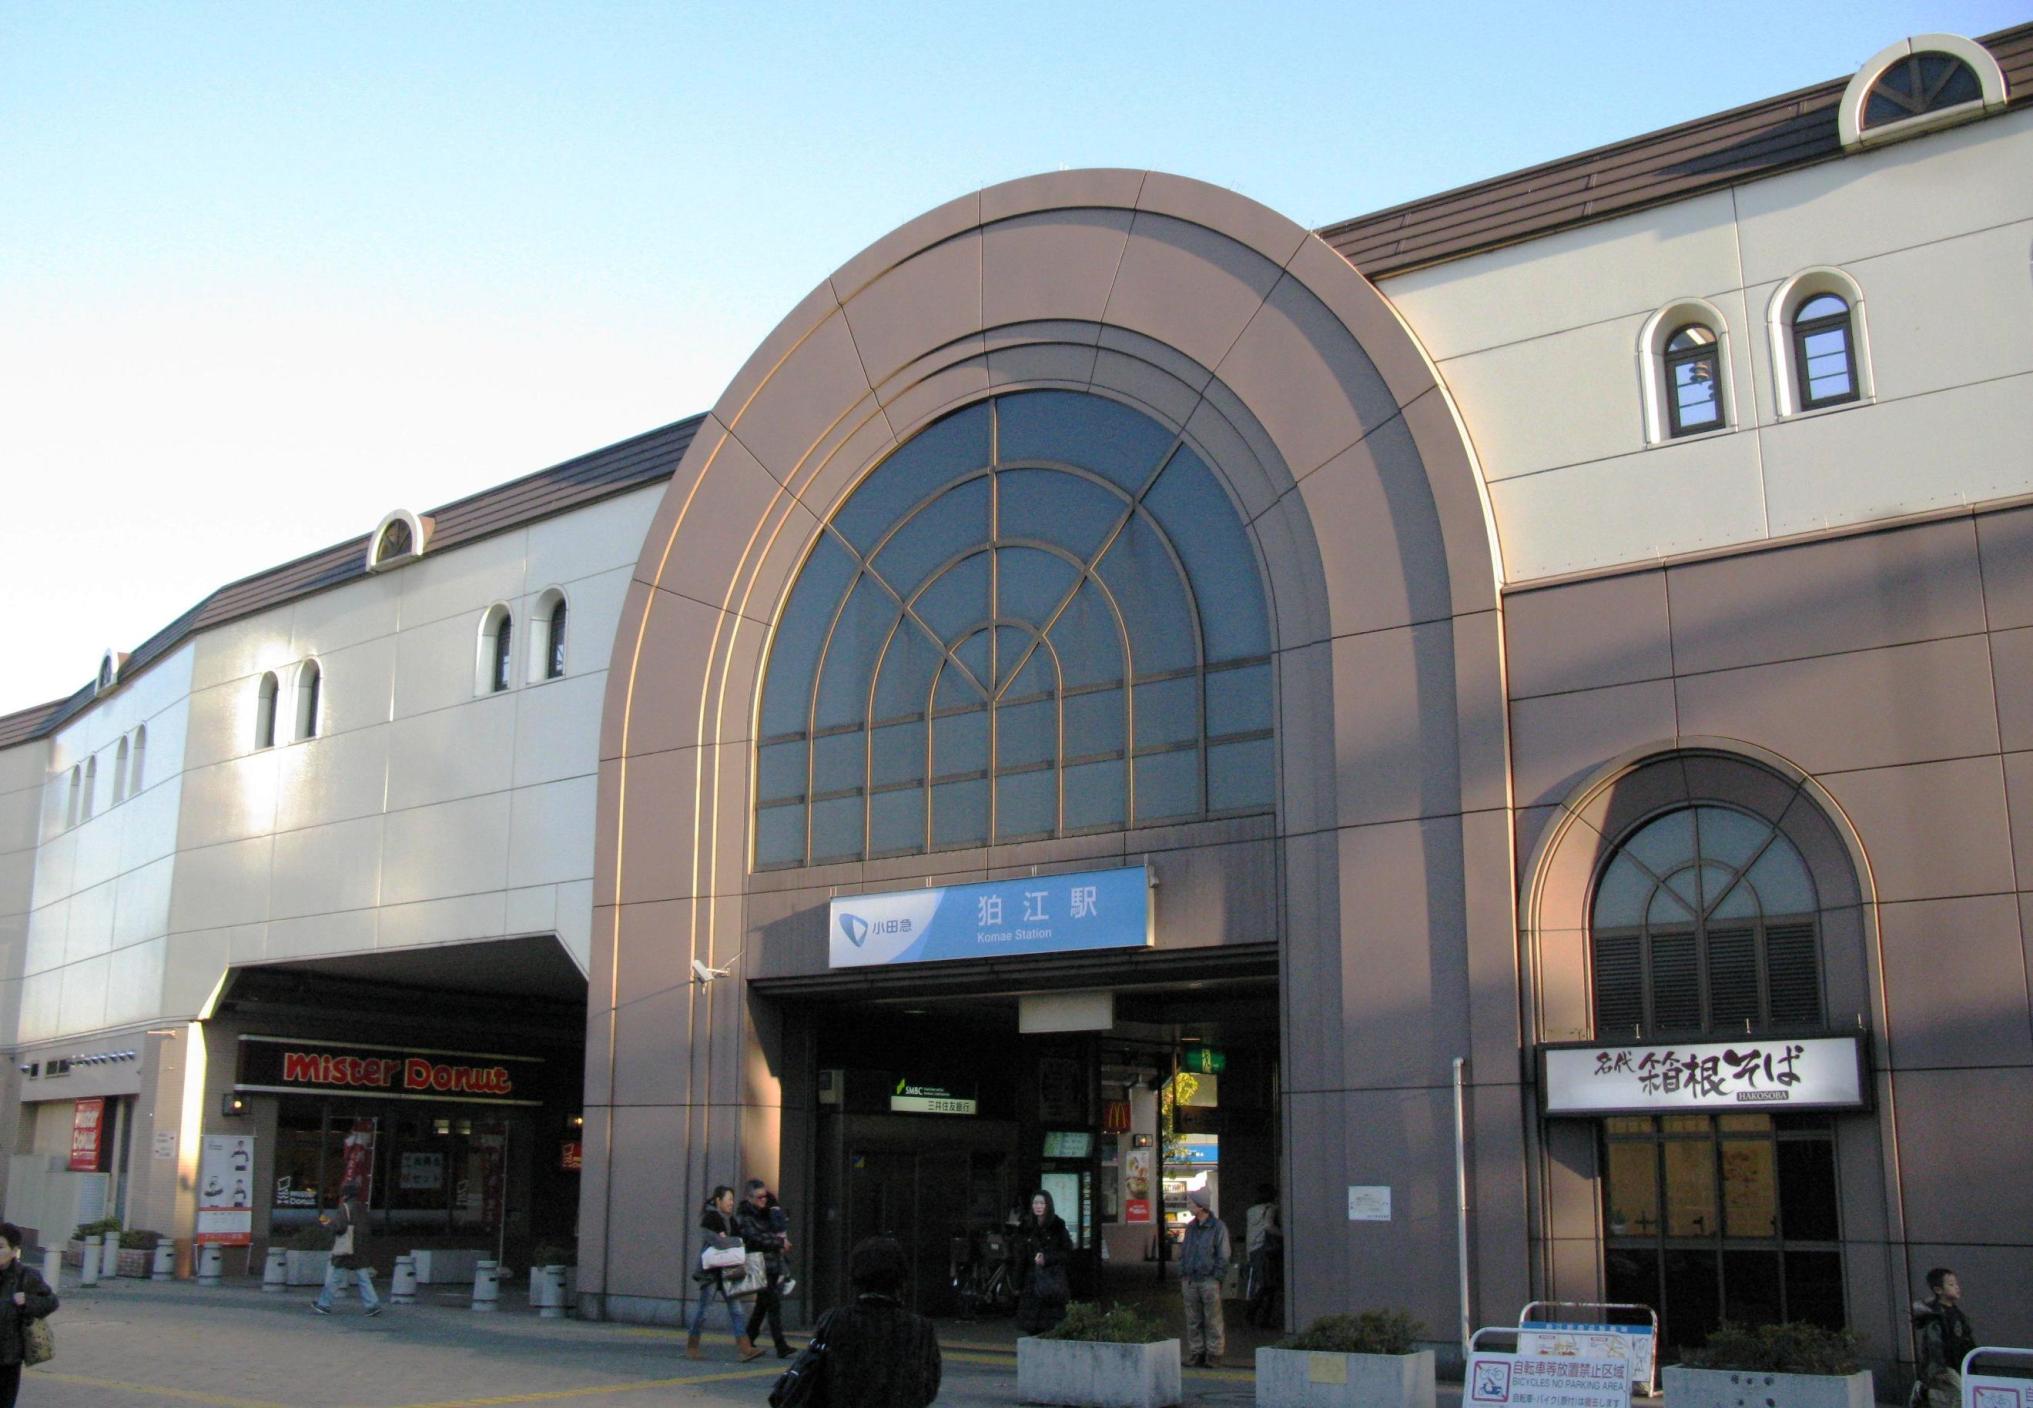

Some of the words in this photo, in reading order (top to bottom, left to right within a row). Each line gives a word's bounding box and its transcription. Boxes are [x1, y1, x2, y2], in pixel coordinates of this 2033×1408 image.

[978, 886, 1097, 926] 狛江駅
[872, 918, 913, 935] 小田急
[977, 931, 1013, 944] Komae
[1015, 927, 1052, 941] Station
[283, 1052, 400, 1087] Mister
[404, 1057, 512, 1094] Donut
[1594, 1051, 1636, 1075] 名代
[1638, 1045, 1804, 1098] 箱根そば
[905, 1086, 923, 1096] SMBC
[1738, 1091, 1788, 1101] HAKOSOBA
[1513, 1360, 1625, 1379] 自転車等放置禁止区域
[1512, 1377, 1549, 1387] BICYCLES
[1552, 1379, 1564, 1388] NO
[1566, 1380, 1600, 1390] PARKING
